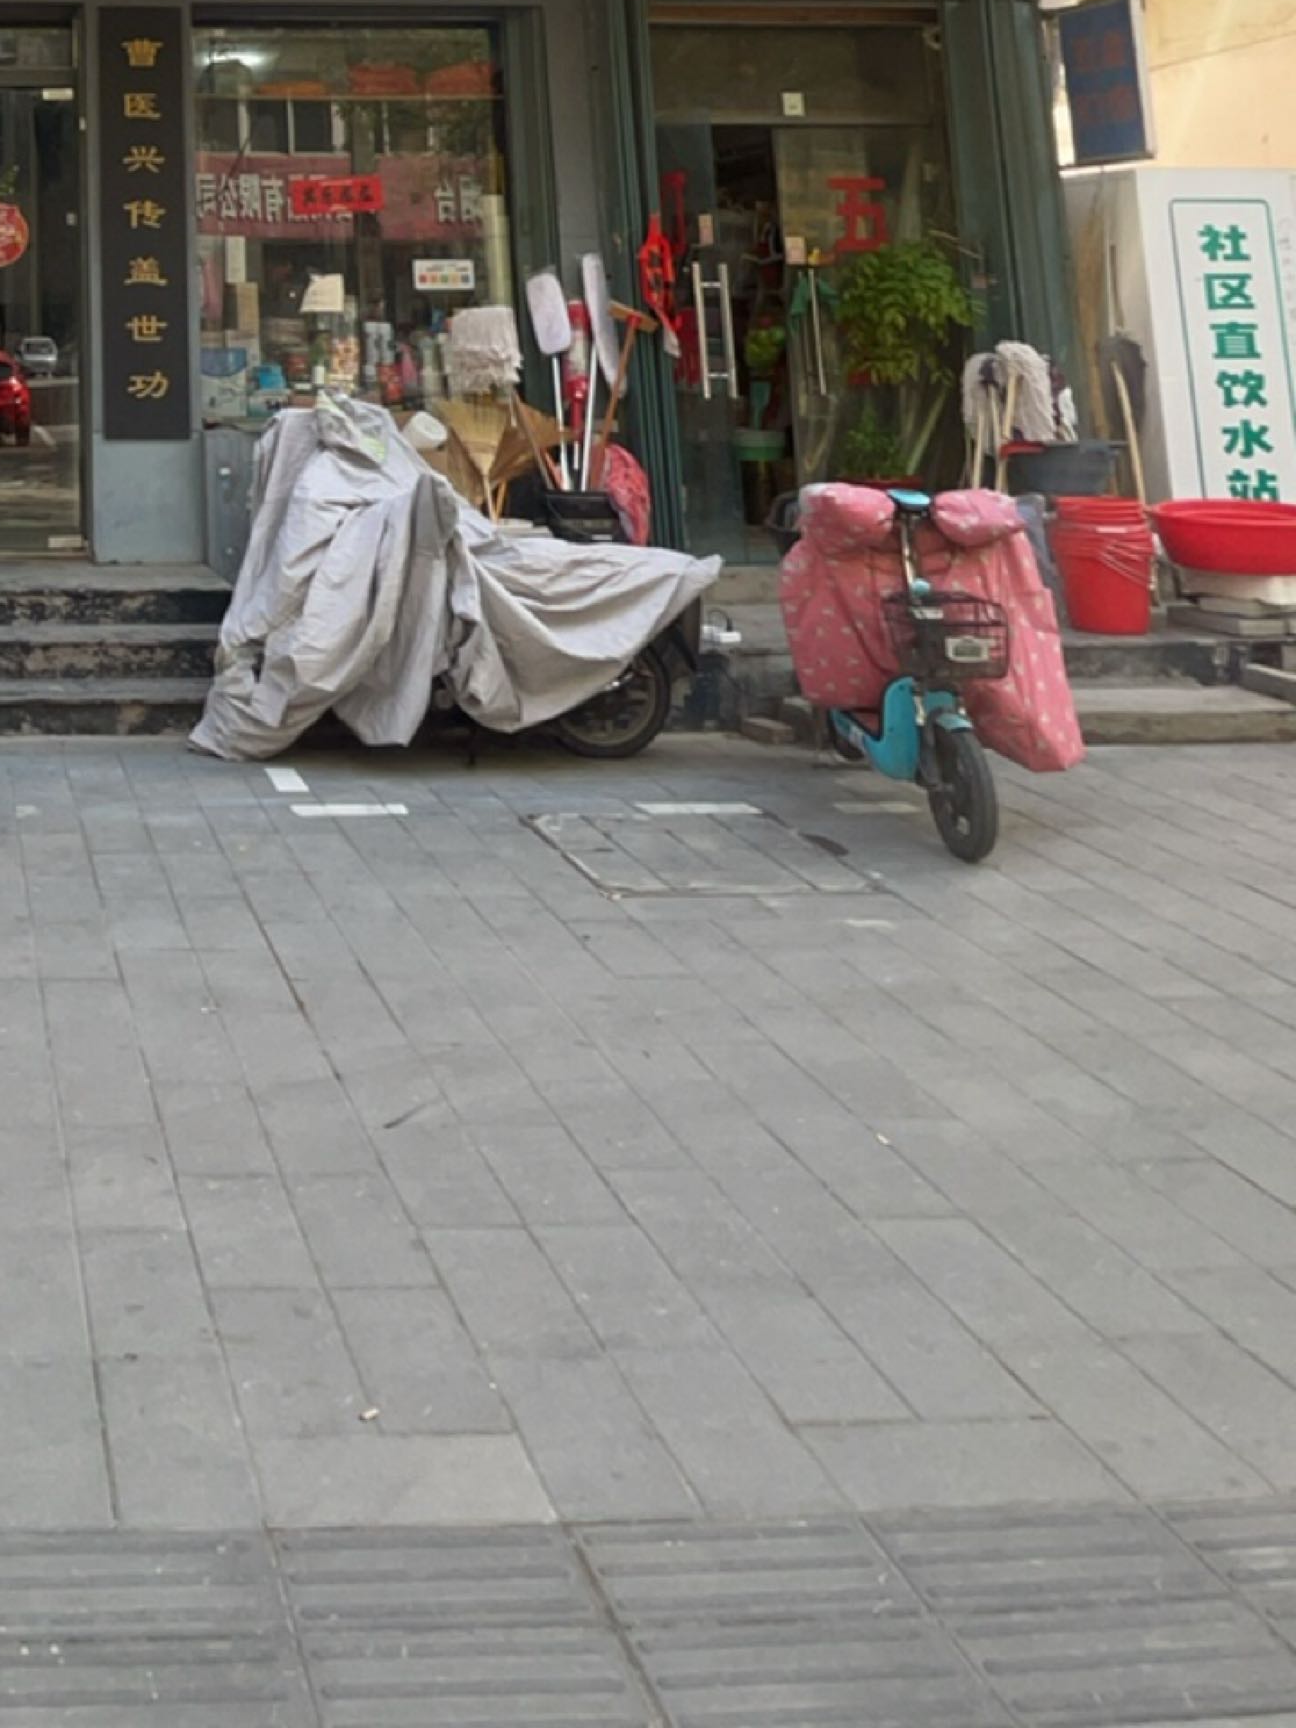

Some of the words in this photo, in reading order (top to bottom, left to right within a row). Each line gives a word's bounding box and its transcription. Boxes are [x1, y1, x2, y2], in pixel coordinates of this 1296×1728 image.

[1198, 224, 1281, 503] 社区直饮水站
